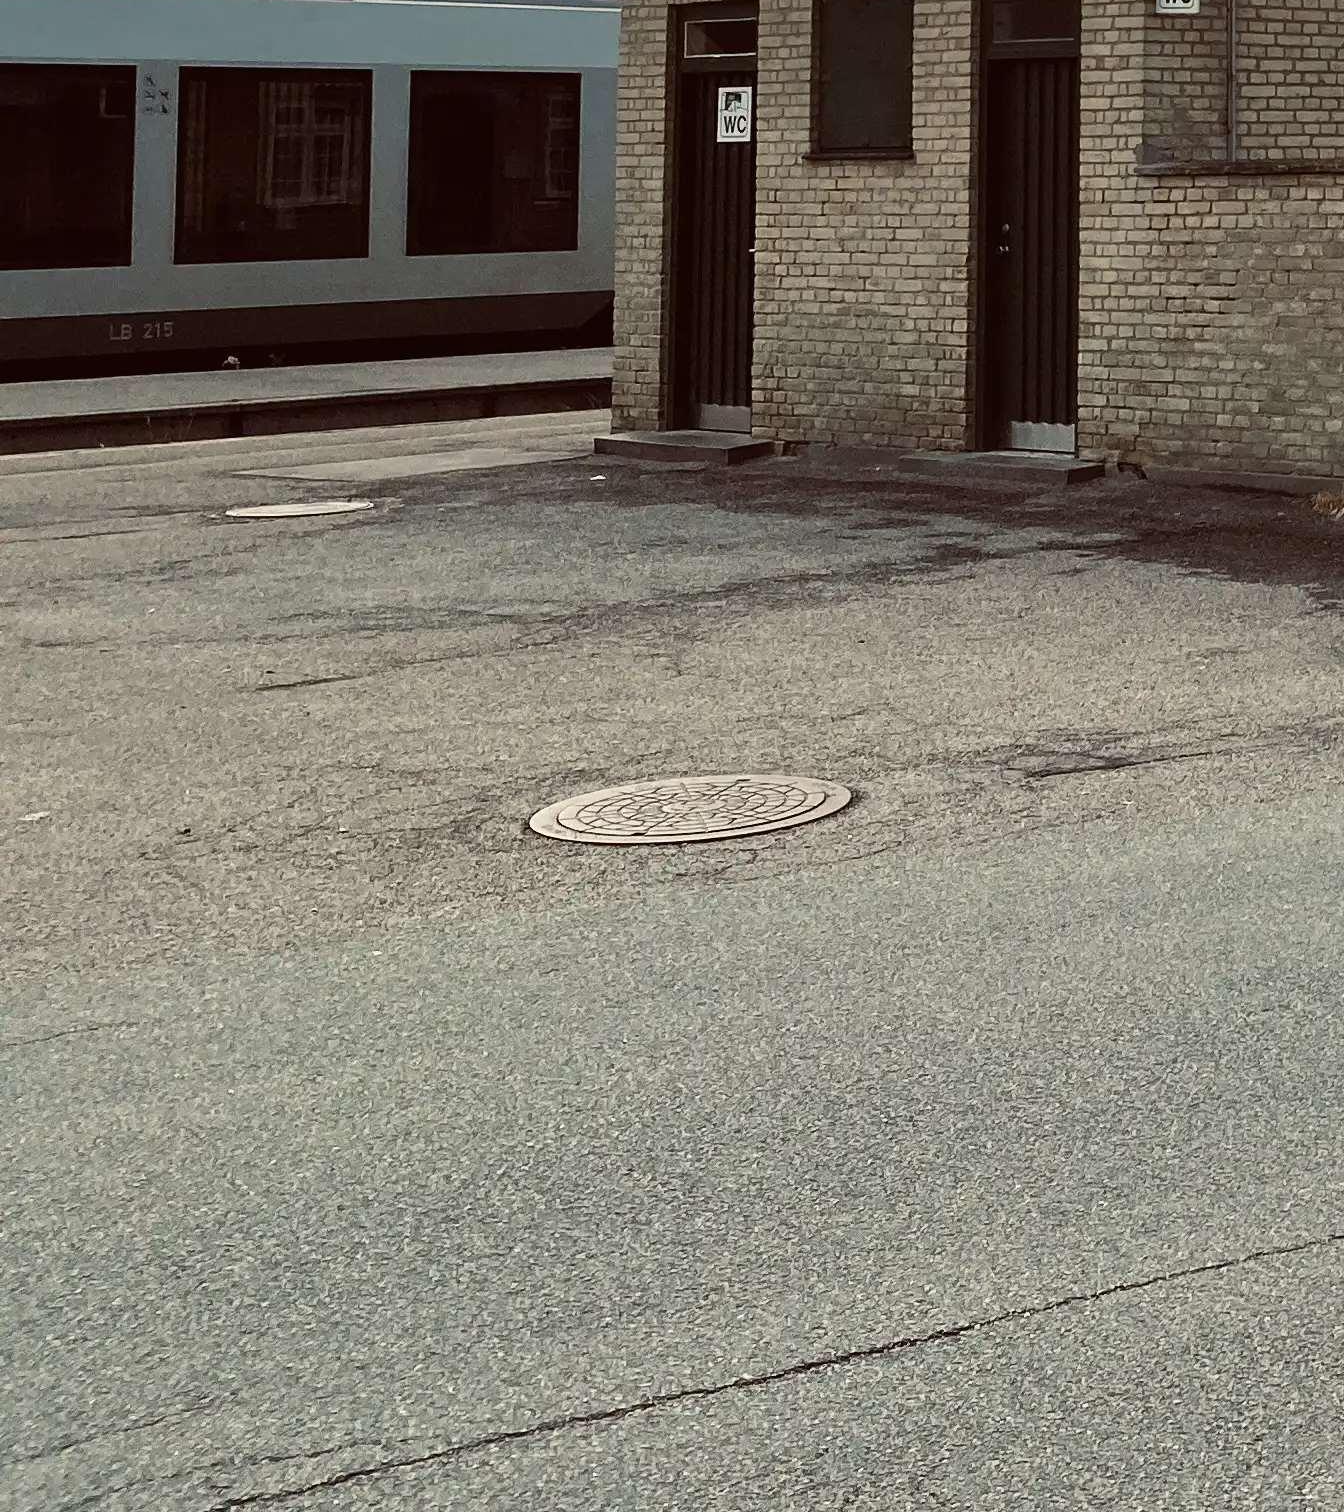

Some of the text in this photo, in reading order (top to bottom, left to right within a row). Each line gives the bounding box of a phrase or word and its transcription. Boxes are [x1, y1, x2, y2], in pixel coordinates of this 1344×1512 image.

[723, 115, 747, 134] WC
[109, 321, 174, 341] LB 215
